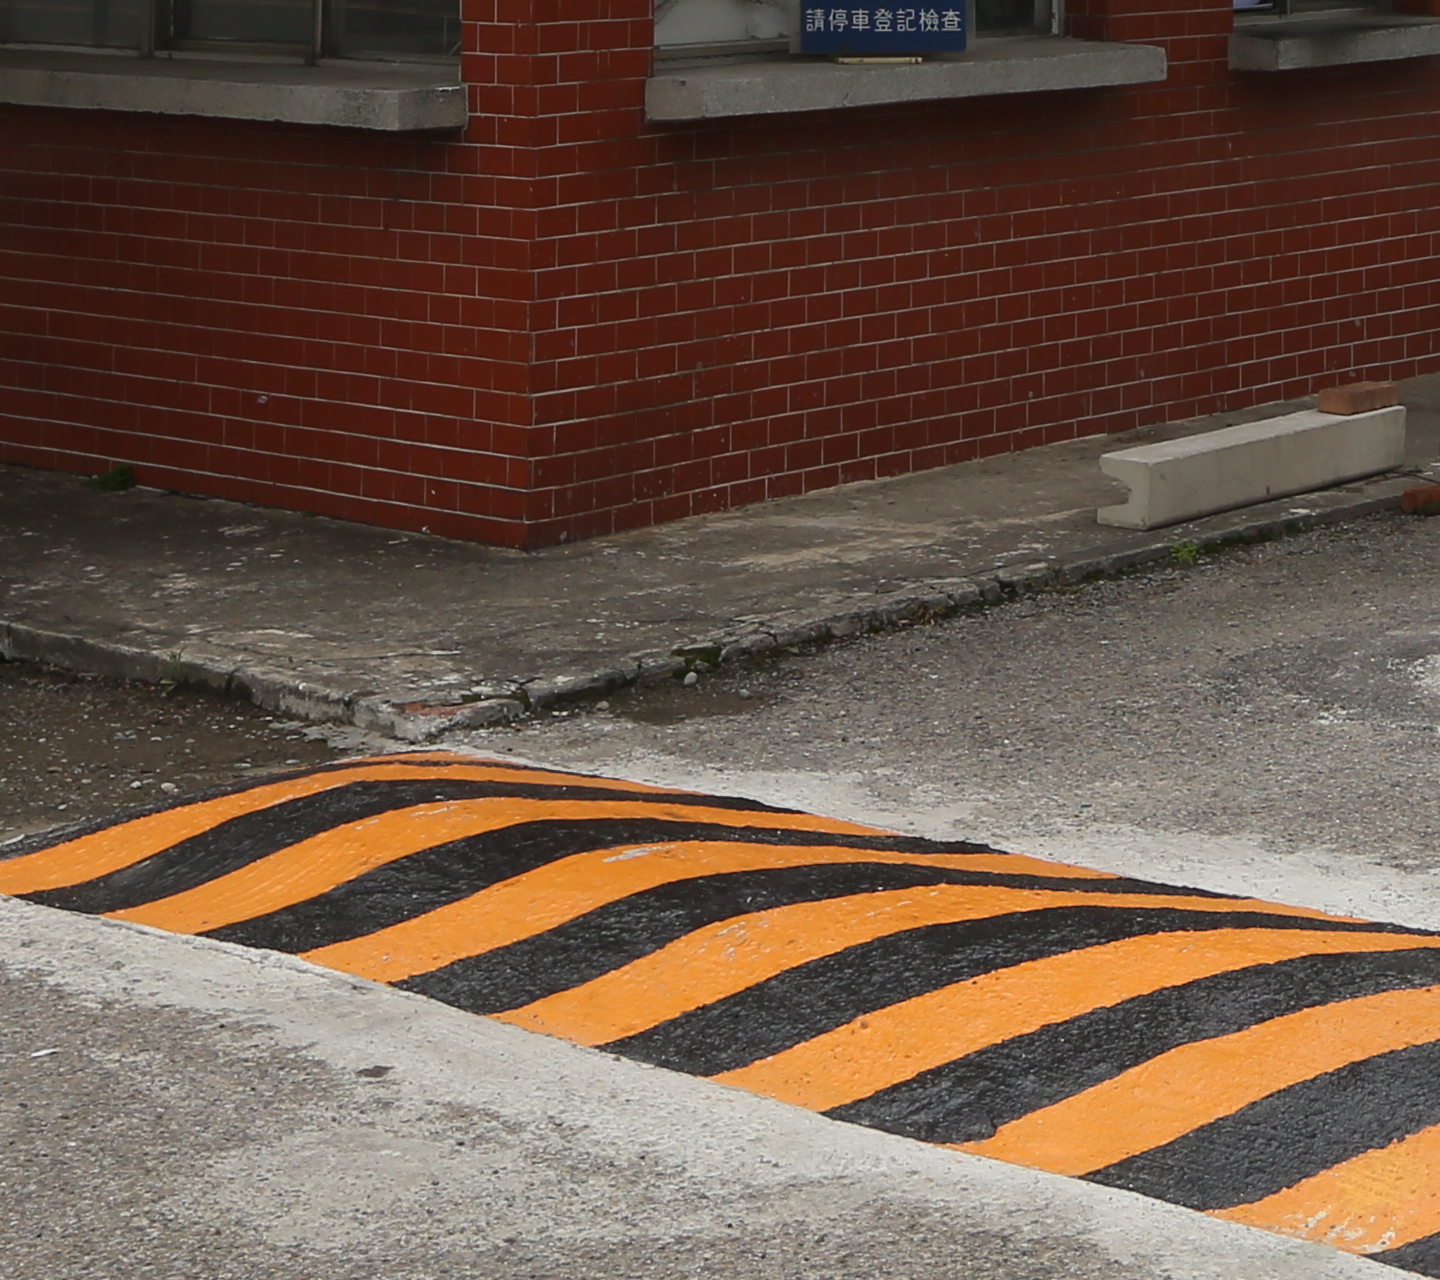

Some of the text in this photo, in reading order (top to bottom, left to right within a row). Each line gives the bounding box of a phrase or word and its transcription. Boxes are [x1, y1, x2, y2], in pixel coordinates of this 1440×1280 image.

[805, 8, 962, 33] 請停車登記檢查
